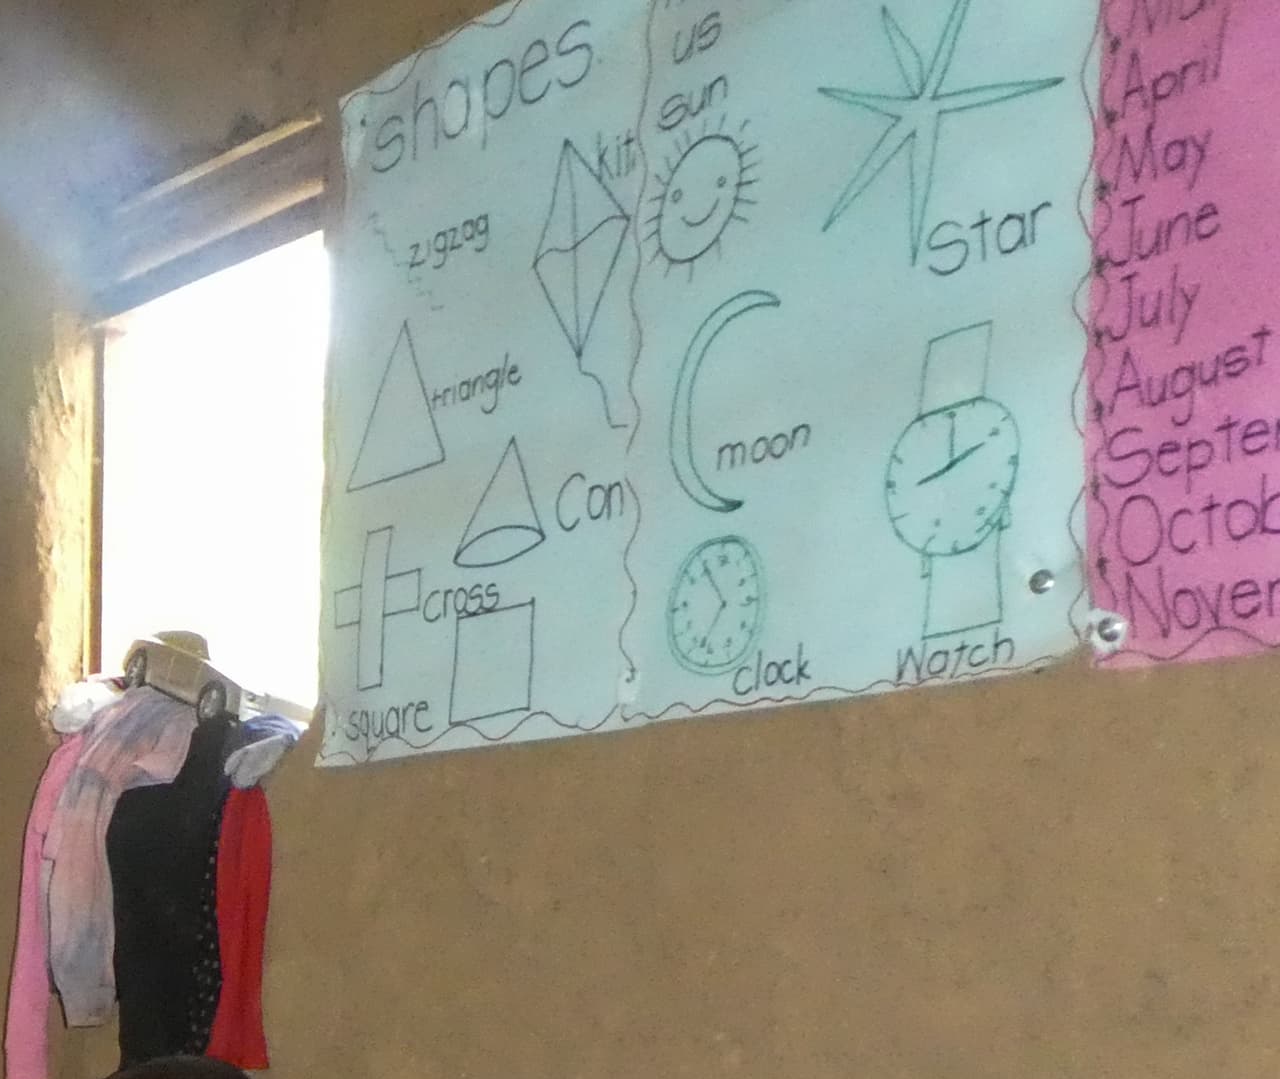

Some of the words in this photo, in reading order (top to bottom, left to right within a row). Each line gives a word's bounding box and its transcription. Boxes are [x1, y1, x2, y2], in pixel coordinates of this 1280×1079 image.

[658, 74, 728, 131] sun
[1112, 121, 1213, 192] May
[408, 212, 491, 270] zigzag
[926, 201, 1053, 277] Star
[1102, 194, 1222, 268] June
[1099, 264, 1201, 345] July
[430, 352, 523, 415] triangle
[1109, 325, 1272, 426] August
[715, 421, 811, 471] moon
[1103, 415, 1280, 494] Septe
[894, 627, 1016, 682] Watch
[345, 699, 434, 754] square
